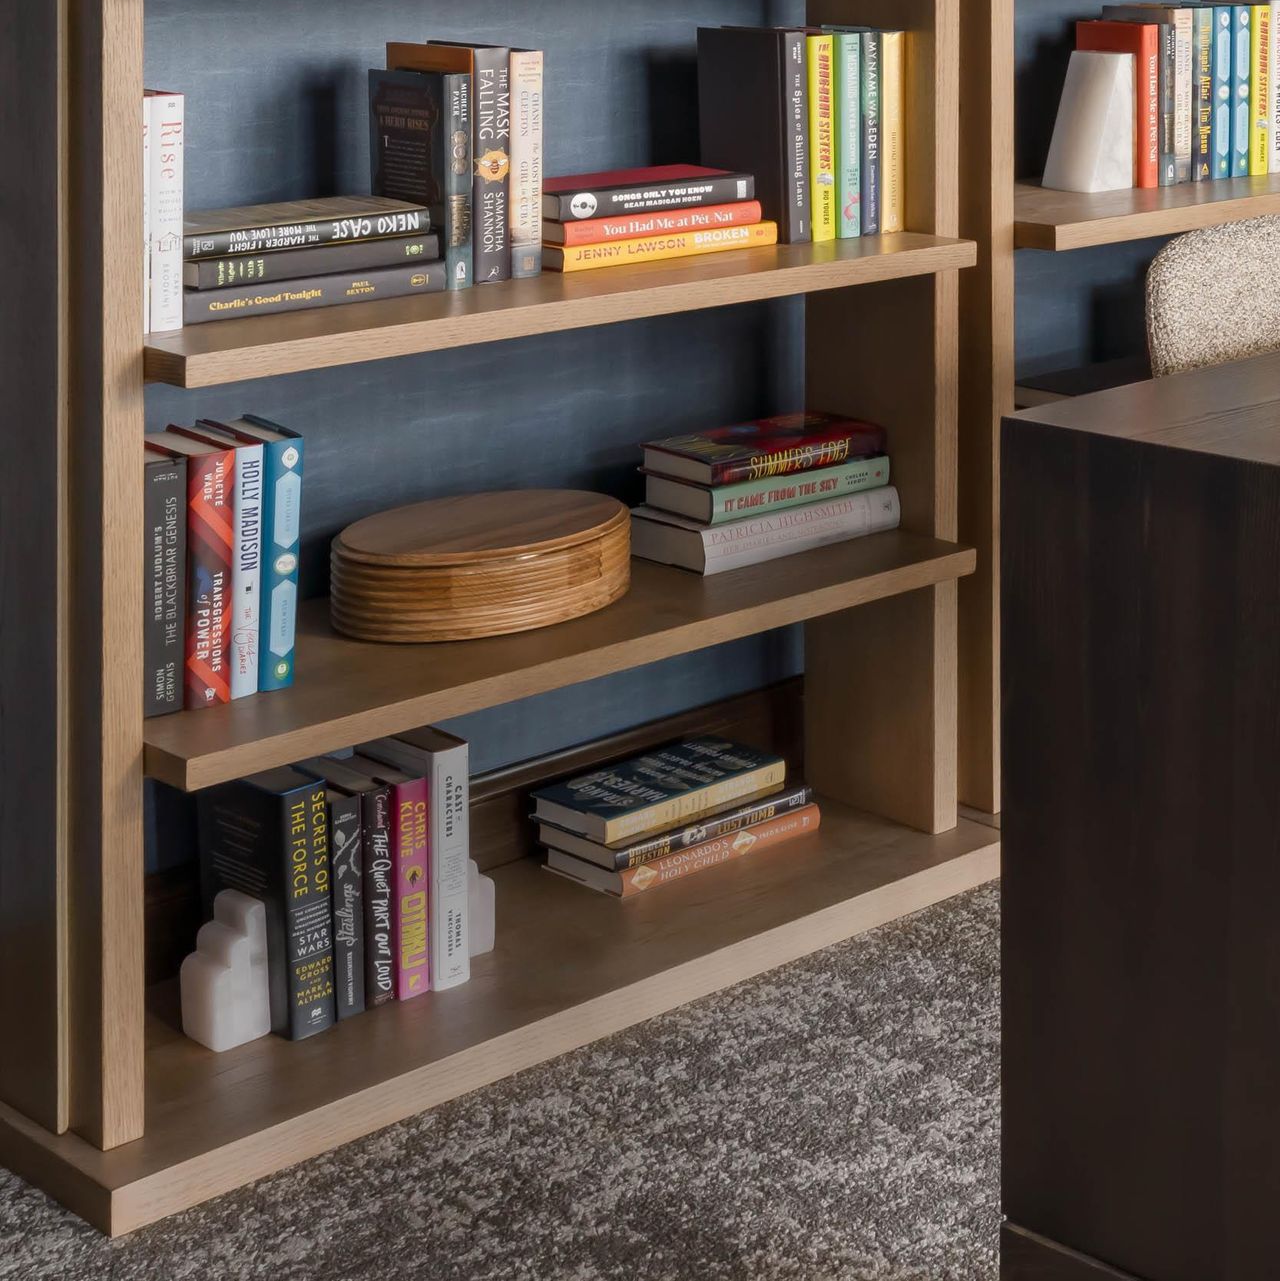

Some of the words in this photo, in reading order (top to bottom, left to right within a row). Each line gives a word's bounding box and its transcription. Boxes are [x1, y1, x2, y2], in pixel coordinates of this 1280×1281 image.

[868, 41, 877, 59] MY
[1200, 26, 1212, 72] Nightingale
[499, 68, 507, 89] THE
[868, 61, 877, 97] NAME
[1200, 76, 1211, 100] Affair
[479, 69, 494, 140] FALLING
[496, 92, 510, 140] MASK
[868, 99, 877, 126] WAS
[1150, 97, 1156, 112] Me
[1200, 106, 1211, 122] Tim
[1150, 114, 1156, 124] at
[160, 122, 182, 179] Rise
[868, 128, 877, 160] EDEN
[1199, 126, 1210, 154] Mason
[612, 193, 642, 202] SONGS
[643, 190, 667, 199] ONLY
[669, 188, 686, 197] YOU
[687, 185, 713, 194] KNOW
[332, 219, 372, 238] CASE
[377, 213, 419, 233] NEKO
[484, 193, 494, 253] SHANNON
[495, 192, 505, 252] SAMANTHA
[602, 223, 627, 236] You
[629, 221, 653, 233] Had
[657, 219, 674, 231] Me
[675, 216, 688, 227] at
[694, 227, 749, 244] BROKEN
[228, 241, 256, 253] FIGHT
[258, 240, 262, 249] I
[266, 236, 306, 248] HARDER
[576, 247, 621, 261] JENNY
[628, 238, 686, 254] LAWSON
[208, 298, 253, 311] Charlie's
[255, 294, 281, 306] Good
[283, 289, 321, 302] Tonight
[204, 473, 212, 501] WADE
[215, 461, 224, 506] JULIETTE
[242, 459, 260, 501] HOLLY
[725, 498, 736, 512] IT
[737, 493, 765, 510] CAME
[768, 486, 796, 503] FROM
[798, 482, 817, 497] THE
[819, 478, 839, 493] SKY
[166, 497, 177, 545] GENESIS
[241, 506, 258, 571] MADISON
[166, 548, 177, 620] BLACKBRIAR
[166, 623, 177, 647] THE
[212, 572, 223, 672] TRANSGRESSIONS
[156, 669, 164, 700] SIMON
[166, 662, 175, 702] GERVAIS
[291, 801, 306, 835] THE
[445, 776, 453, 838] CHARACTERS
[717, 818, 743, 834] LOST
[744, 806, 775, 826] TOMB
[311, 791, 326, 867] SECRETS
[400, 801, 413, 857] KLUWE
[413, 802, 425, 848] CHRIS
[660, 839, 729, 870] LEONARDO'S
[660, 863, 689, 881] HOLY
[694, 851, 730, 872] CHILD
[292, 841, 308, 898] FORCE
[314, 869, 327, 893] OF
[297, 937, 331, 957] WARS
[299, 929, 327, 946] STAR
[295, 954, 332, 975] EDWARD
[299, 965, 330, 981] GROSS
[296, 986, 322, 999] MARK
